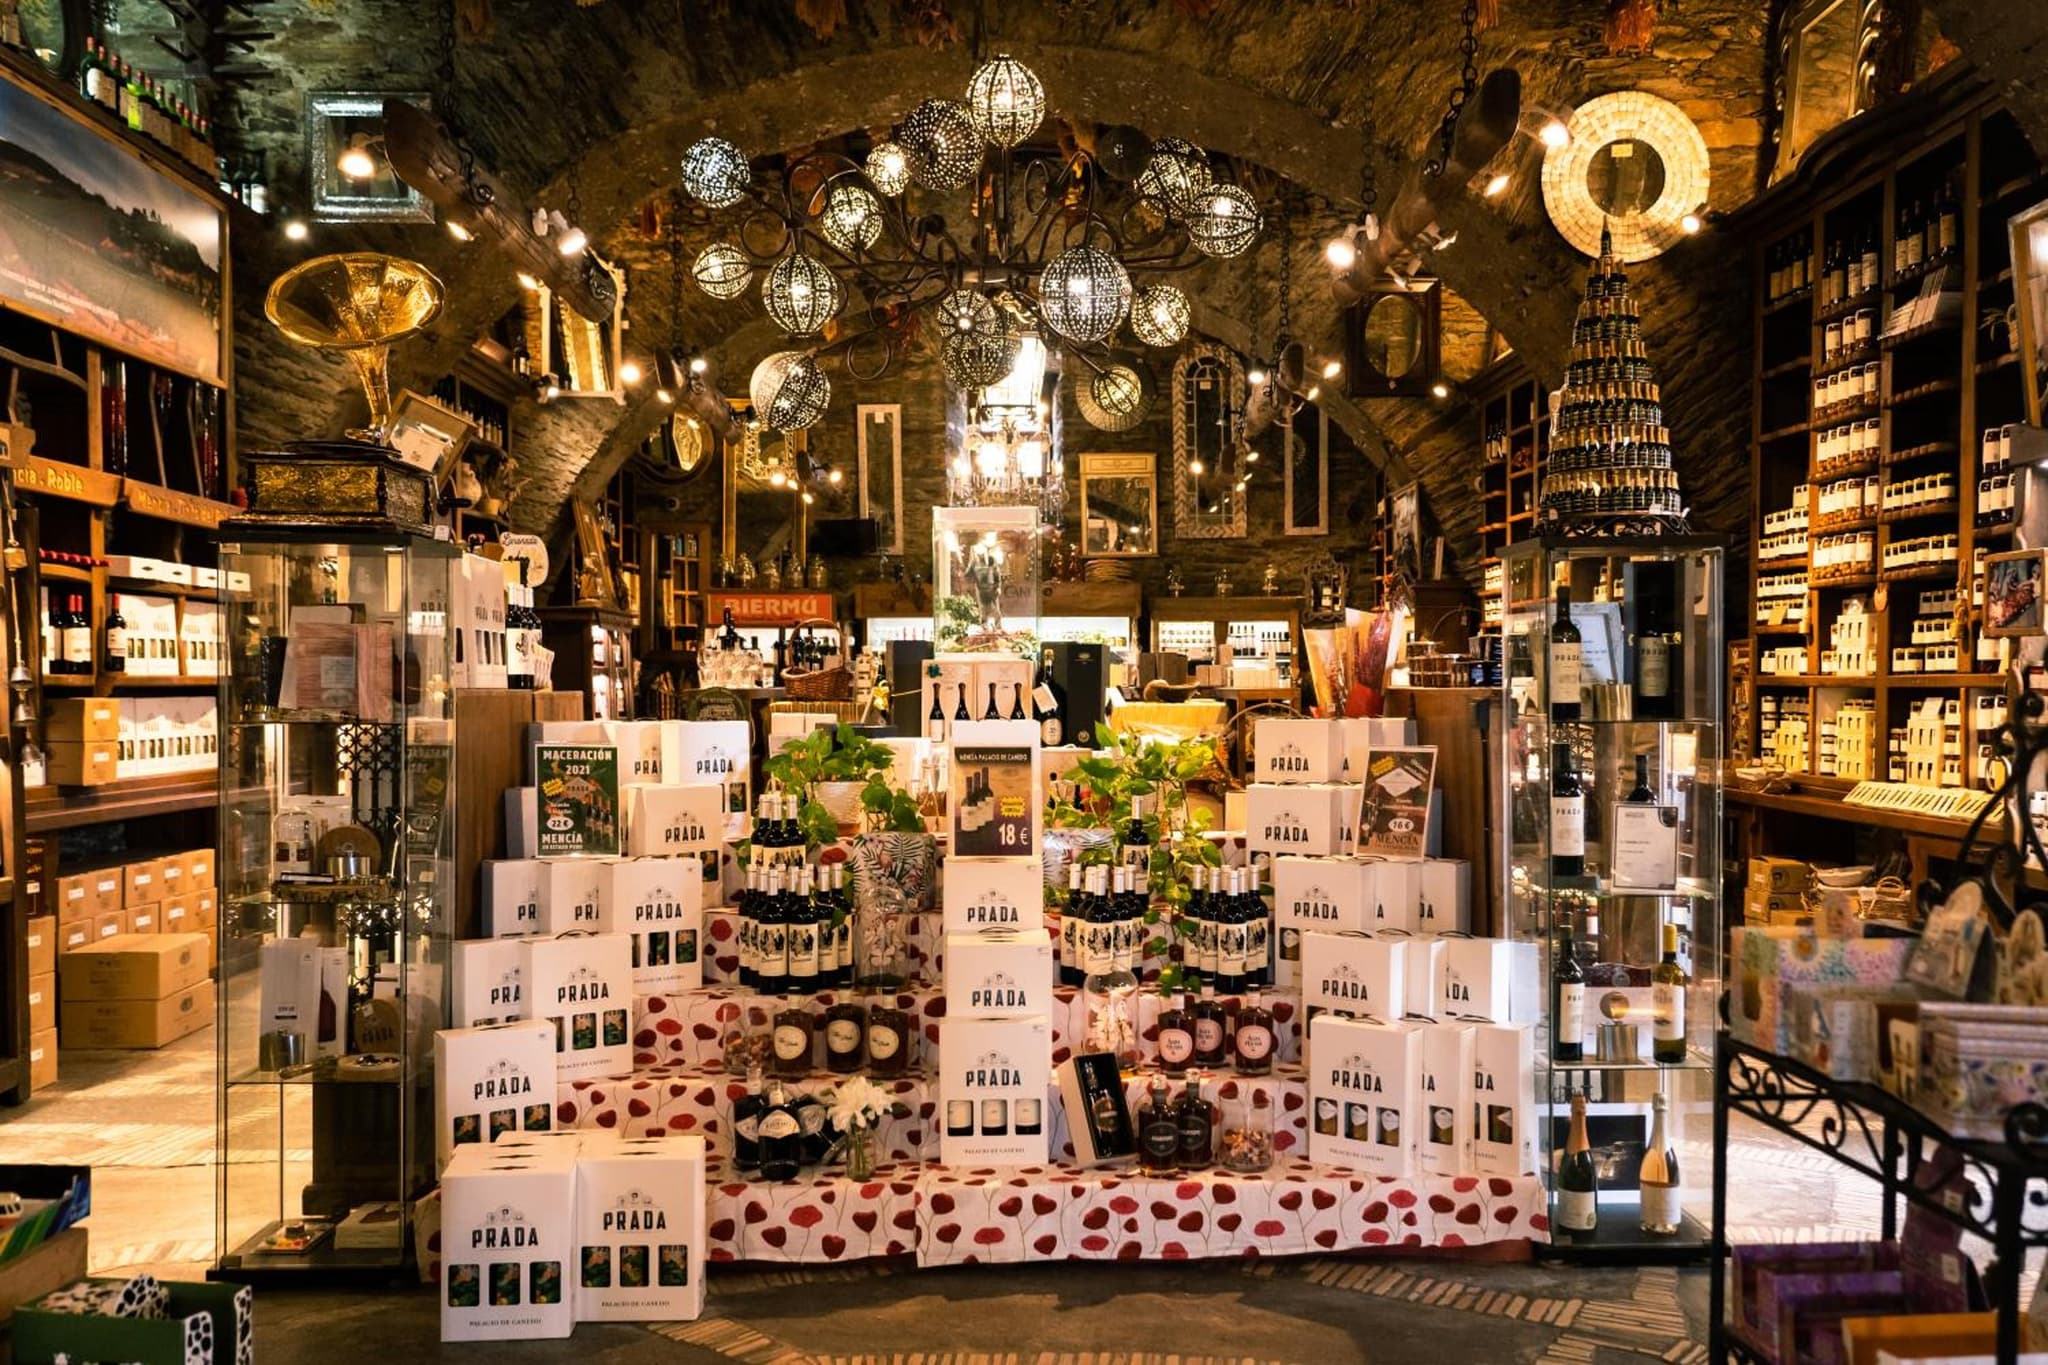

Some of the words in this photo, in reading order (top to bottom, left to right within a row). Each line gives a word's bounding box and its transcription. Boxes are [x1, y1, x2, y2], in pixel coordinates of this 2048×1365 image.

[47, 468, 84, 495] Roble
[725, 596, 817, 615] BIERMÚ
[543, 748, 612, 761] MACERACIÓN
[566, 765, 590, 775] 2021
[634, 760, 662, 776] PRA
[696, 759, 734, 774] PRADA
[1271, 757, 1309, 772] PRADA
[542, 831, 583, 843] MENCÍA
[665, 826, 705, 843] PRADA
[999, 824, 1015, 846] 18
[1020, 827, 1029, 845] €
[1265, 826, 1309, 843] PRADA
[635, 902, 683, 921] PRADA
[968, 906, 1018, 923] PRADA
[1294, 902, 1338, 920] PRADA
[491, 983, 520, 1005] PRA
[558, 982, 609, 1003] PRADA
[972, 989, 1027, 1007] PRADA
[1322, 979, 1368, 1001] PRADA
[966, 1069, 1021, 1087] PRADA
[1332, 1069, 1383, 1093] PRADA
[474, 1076, 531, 1100] PRADA
[603, 1210, 666, 1231] PRADA
[472, 1226, 539, 1249] PRADA
